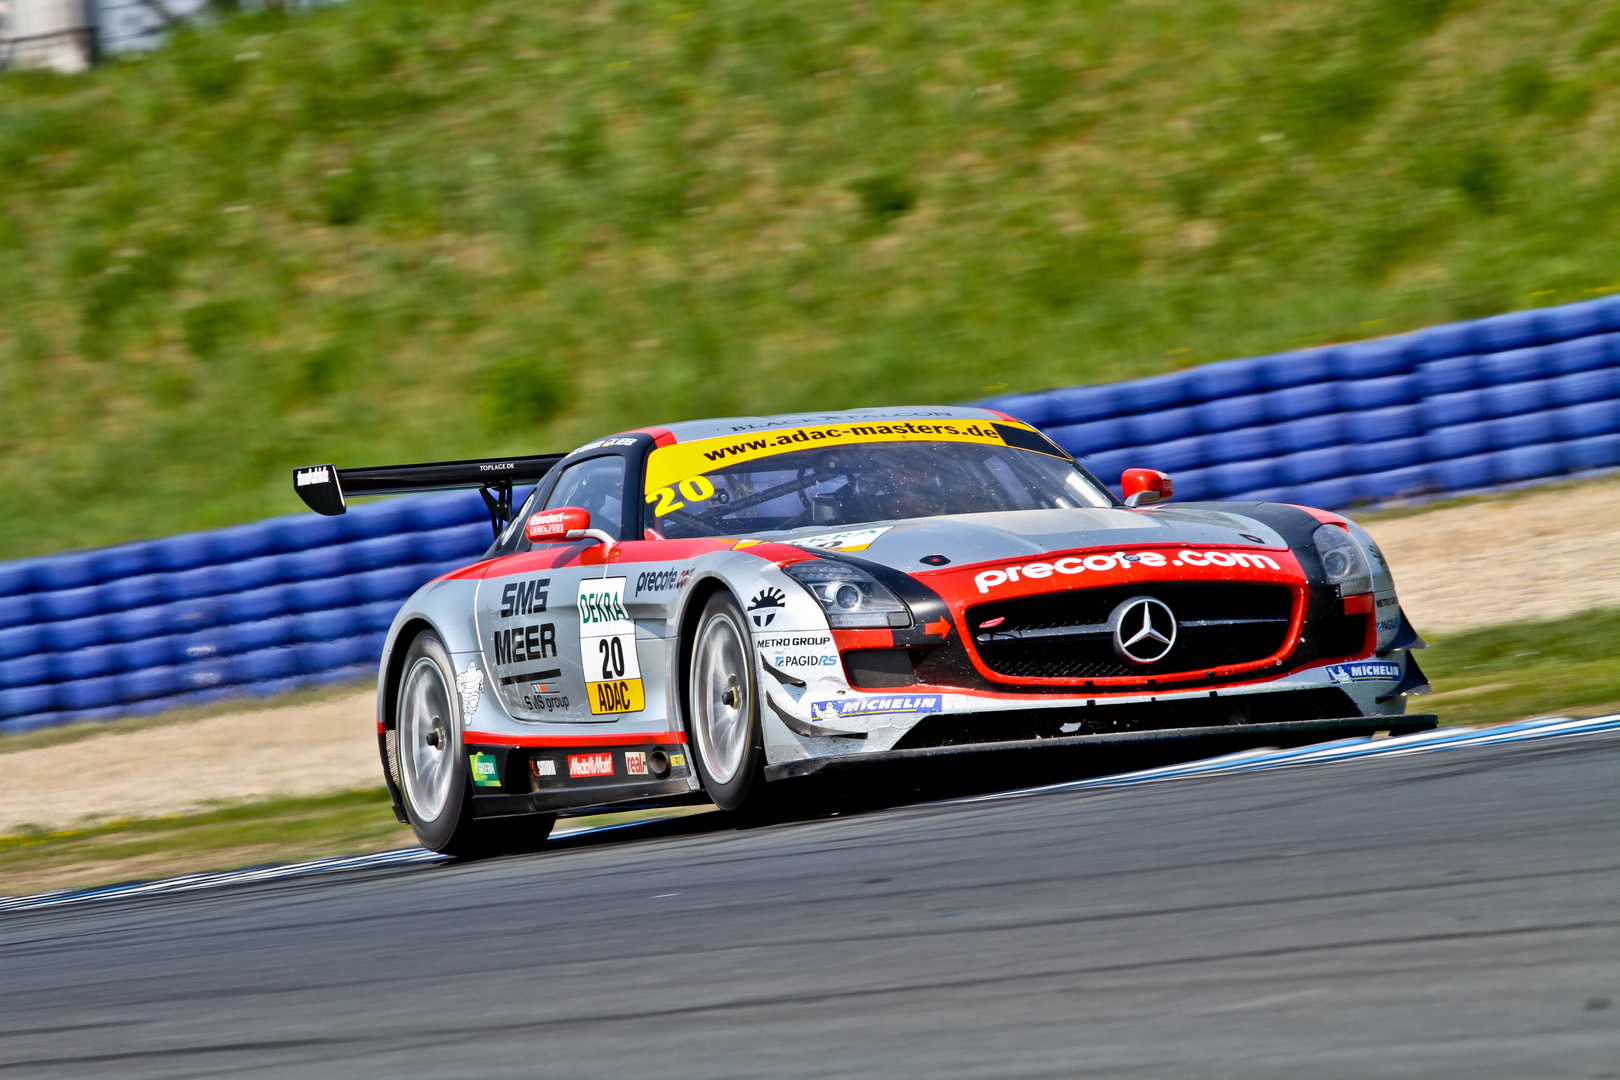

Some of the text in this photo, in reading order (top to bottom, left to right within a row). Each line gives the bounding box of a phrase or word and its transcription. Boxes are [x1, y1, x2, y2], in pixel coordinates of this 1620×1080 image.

[703, 422, 999, 461] www.adac-masters.de
[479, 463, 515, 471] TOPLAGE.DE
[645, 475, 716, 517] 20
[974, 549, 1281, 594] precote.com
[500, 577, 551, 618] SMS
[579, 591, 630, 624] DEKRA
[493, 622, 558, 666] MEER
[599, 636, 625, 680] 20
[757, 637, 830, 648] METRO GROUP
[785, 655, 838, 667] PAGID RS
[1351, 665, 1399, 677] MICHELIN
[546, 694, 570, 712] group
[597, 681, 631, 712] ADAC
[842, 697, 937, 713] MICHELIN
